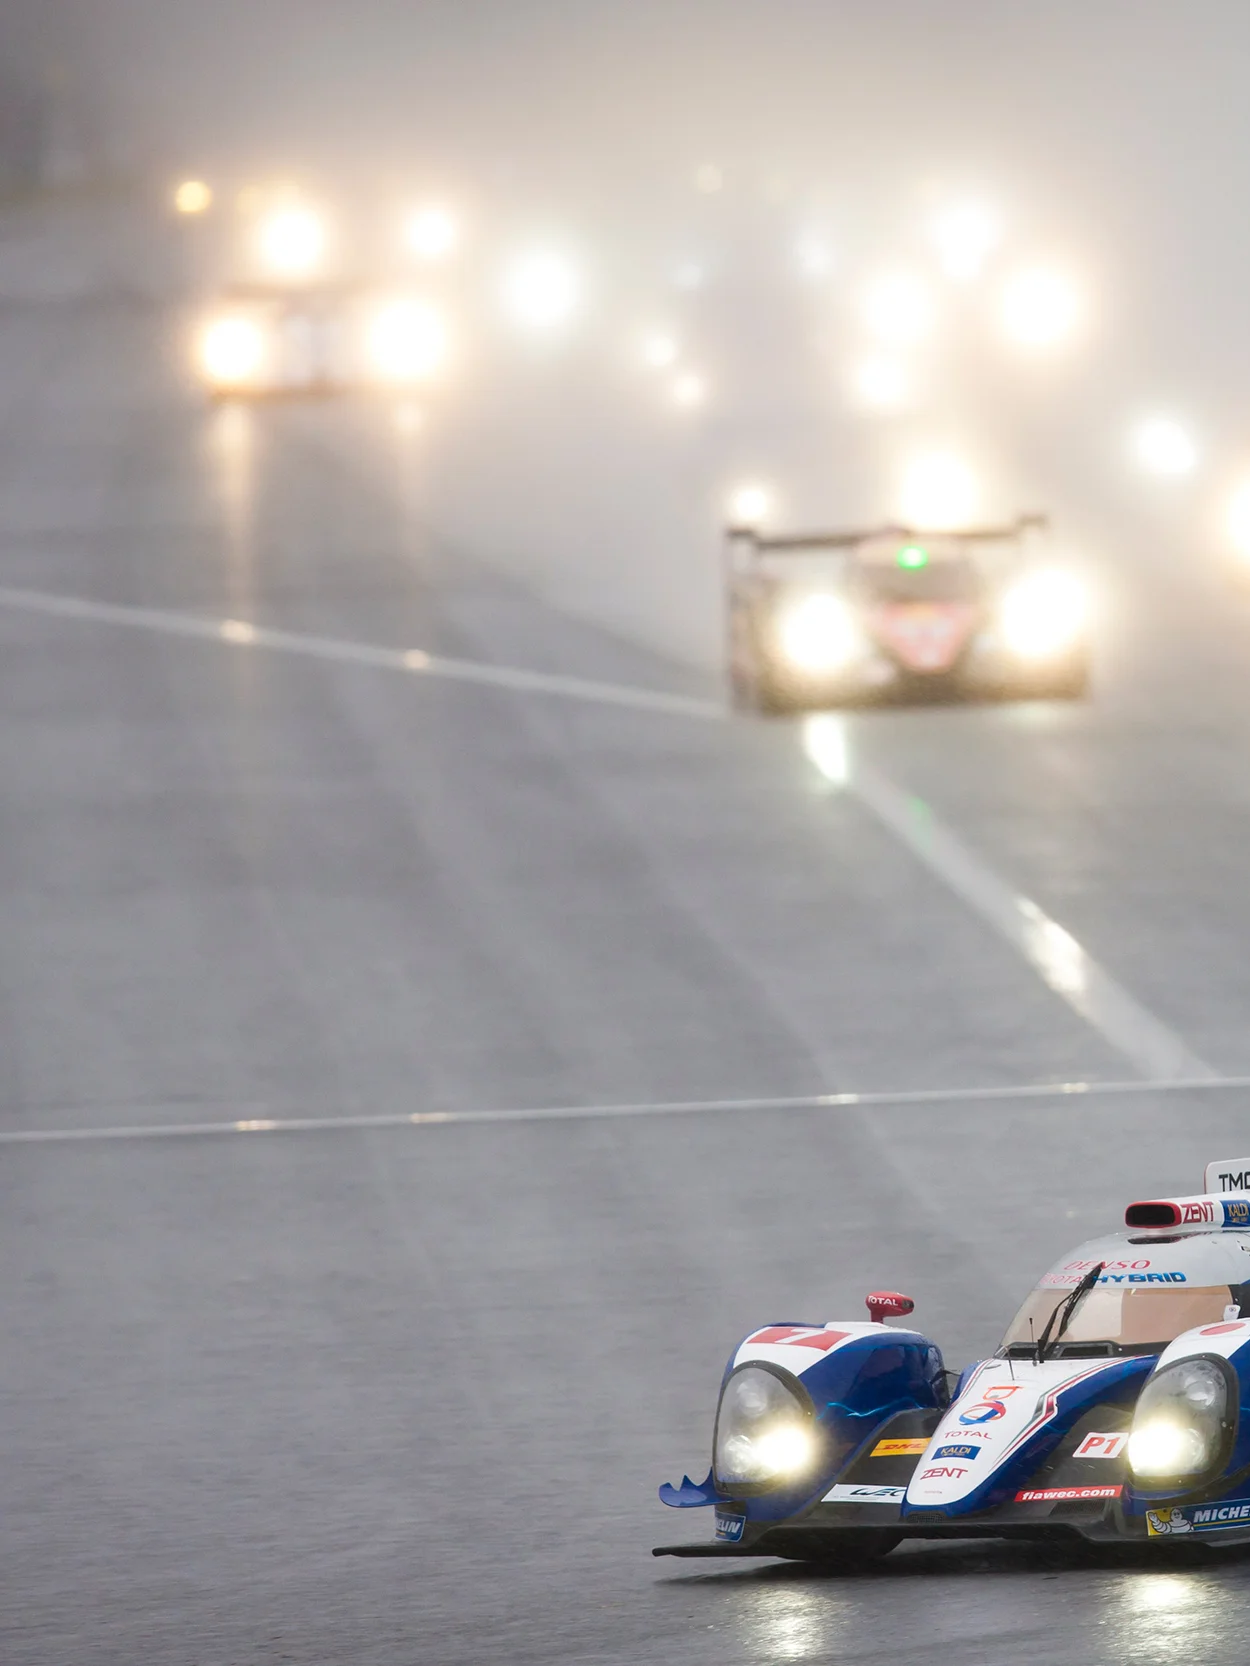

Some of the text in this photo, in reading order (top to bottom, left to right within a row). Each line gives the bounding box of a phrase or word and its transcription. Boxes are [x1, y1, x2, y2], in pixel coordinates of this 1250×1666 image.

[1181, 1202, 1214, 1224] ZENT
[1227, 1203, 1249, 1217] KALDI
[1092, 1272, 1187, 1283] HYBRID
[774, 1328, 827, 1343] 7
[944, 1431, 992, 1440] TOTAL
[941, 1446, 971, 1455] KALDI
[1080, 1437, 1120, 1454] P1
[920, 1467, 968, 1480] ZENT
[1022, 1488, 1116, 1500] fiawec.com
